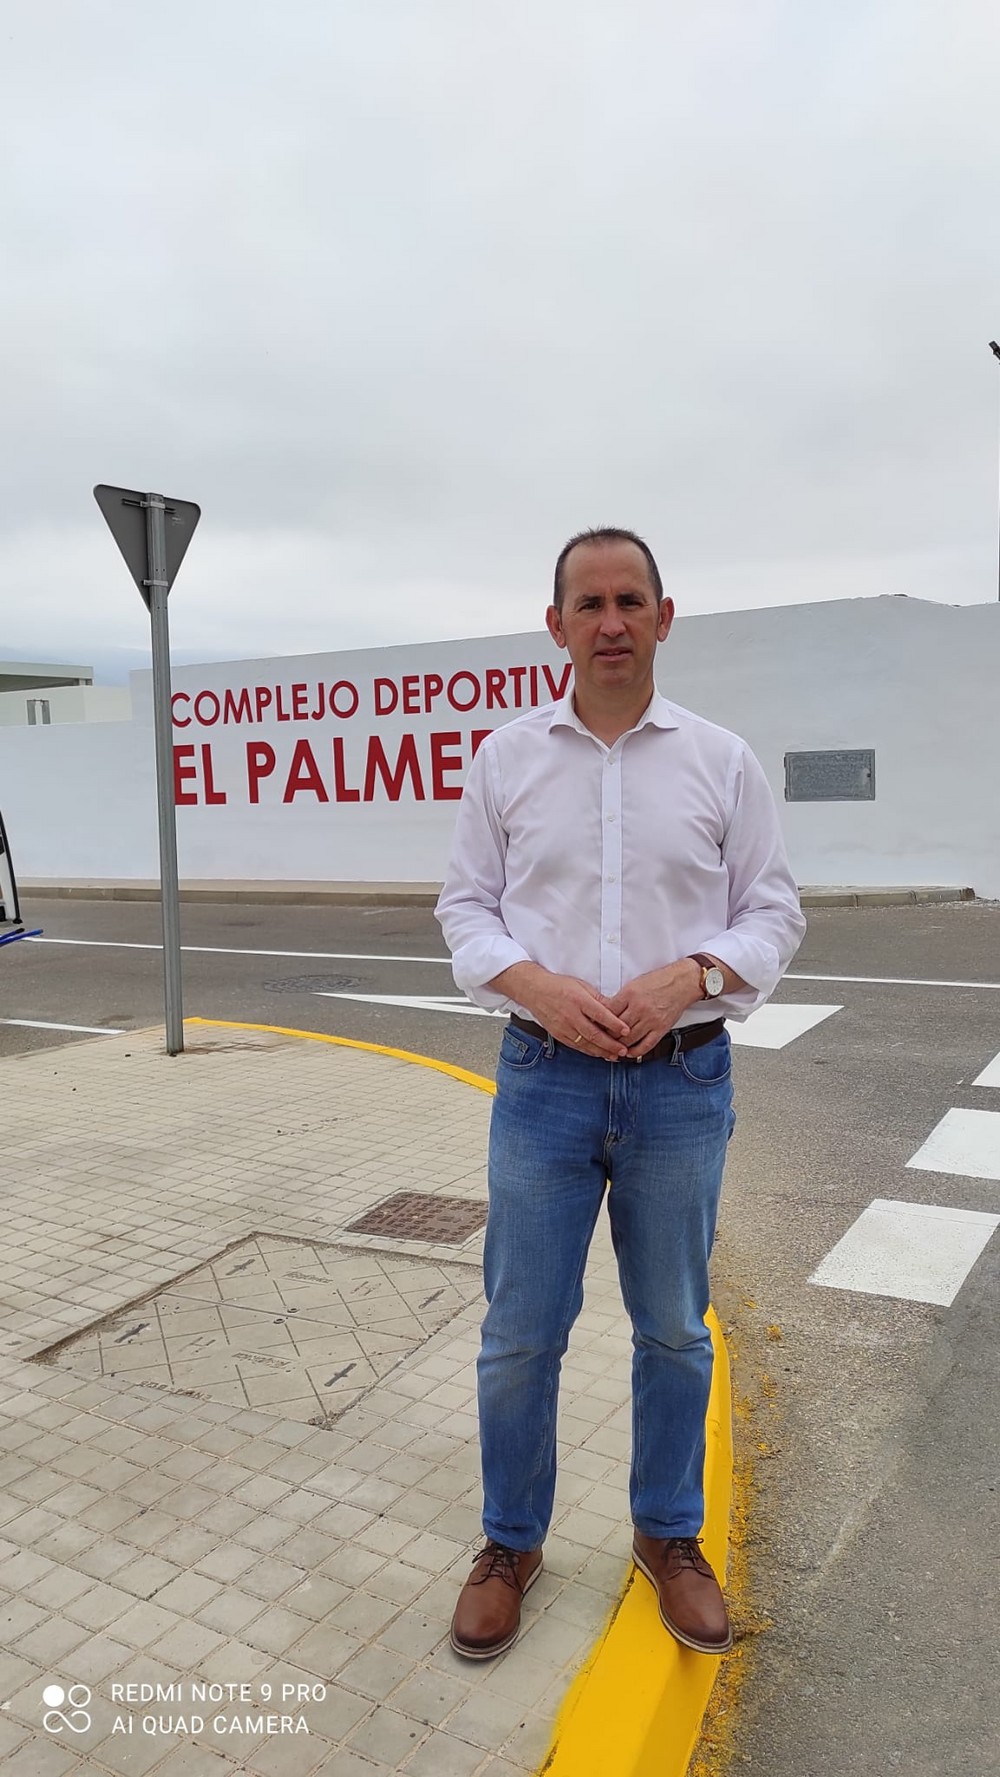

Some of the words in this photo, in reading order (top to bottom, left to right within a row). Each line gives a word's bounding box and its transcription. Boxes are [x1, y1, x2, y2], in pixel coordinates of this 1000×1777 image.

[171, 680, 360, 728] COMPLEJO
[173, 743, 227, 806] EL
[246, 729, 493, 805] PALME
